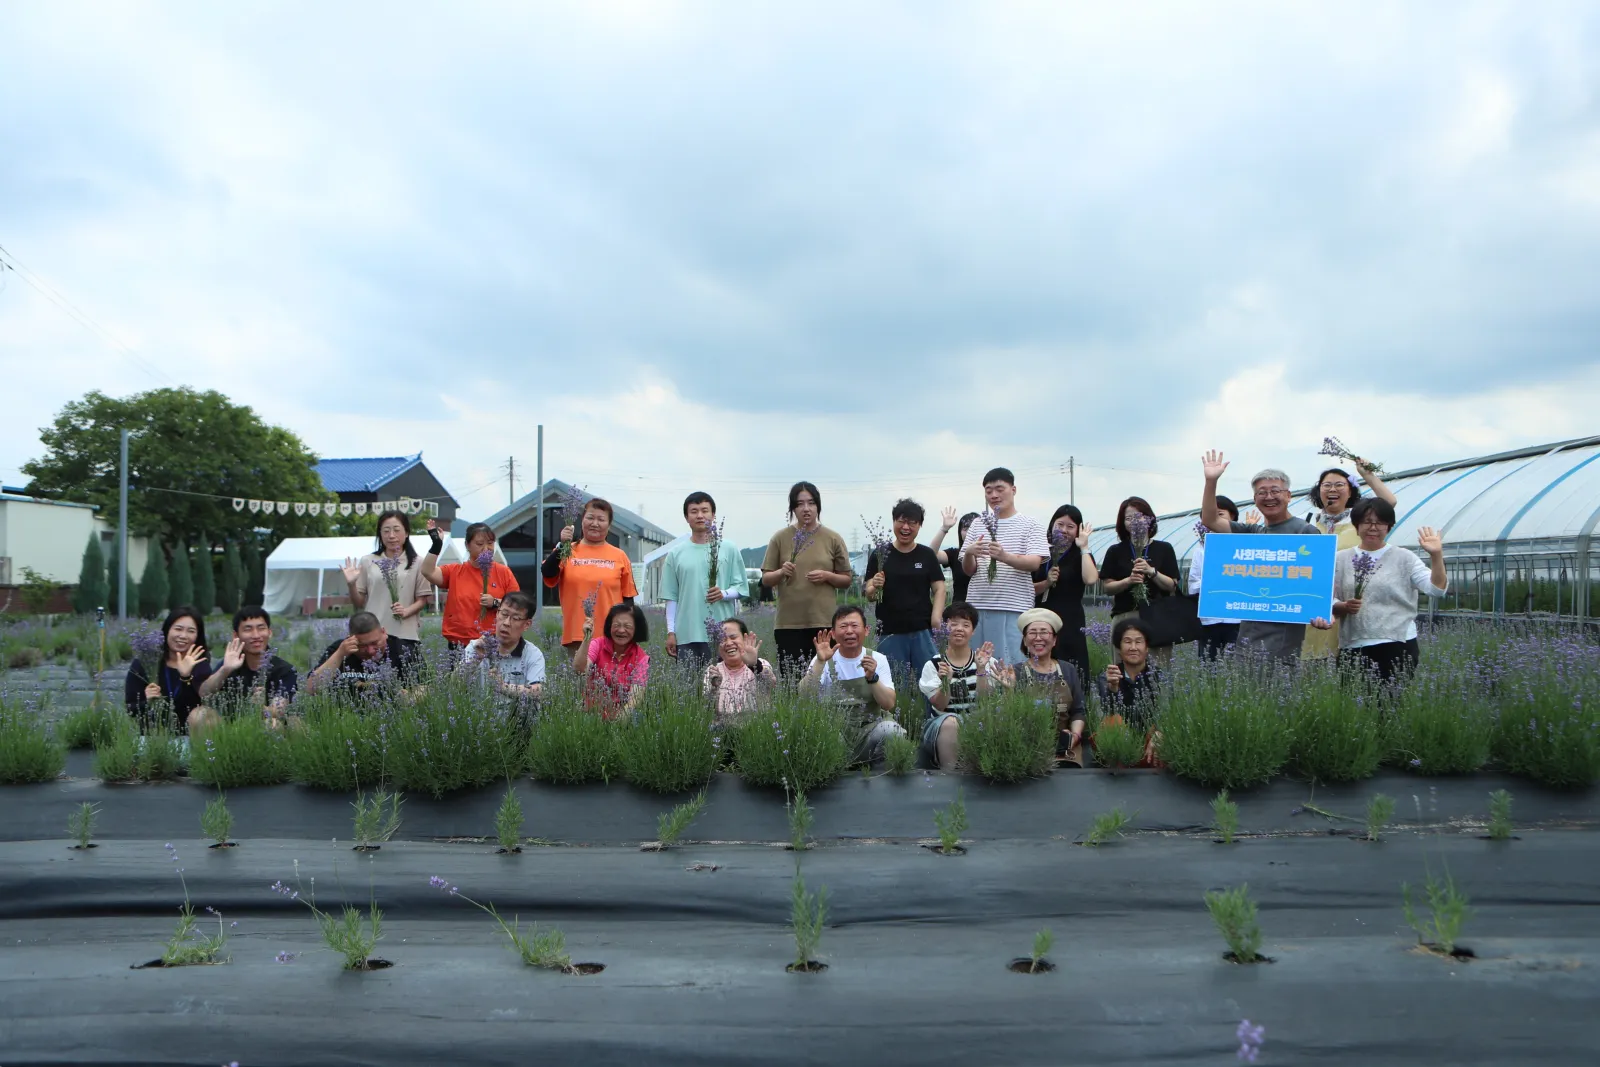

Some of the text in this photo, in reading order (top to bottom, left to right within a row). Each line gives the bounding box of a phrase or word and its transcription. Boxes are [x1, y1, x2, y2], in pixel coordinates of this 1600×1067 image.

[1232, 548, 1297, 561] 사회적농업은
[1222, 564, 1313, 580] 지역사회의 활력
[1225, 601, 1303, 614] 농업회사법인 그라스팜
